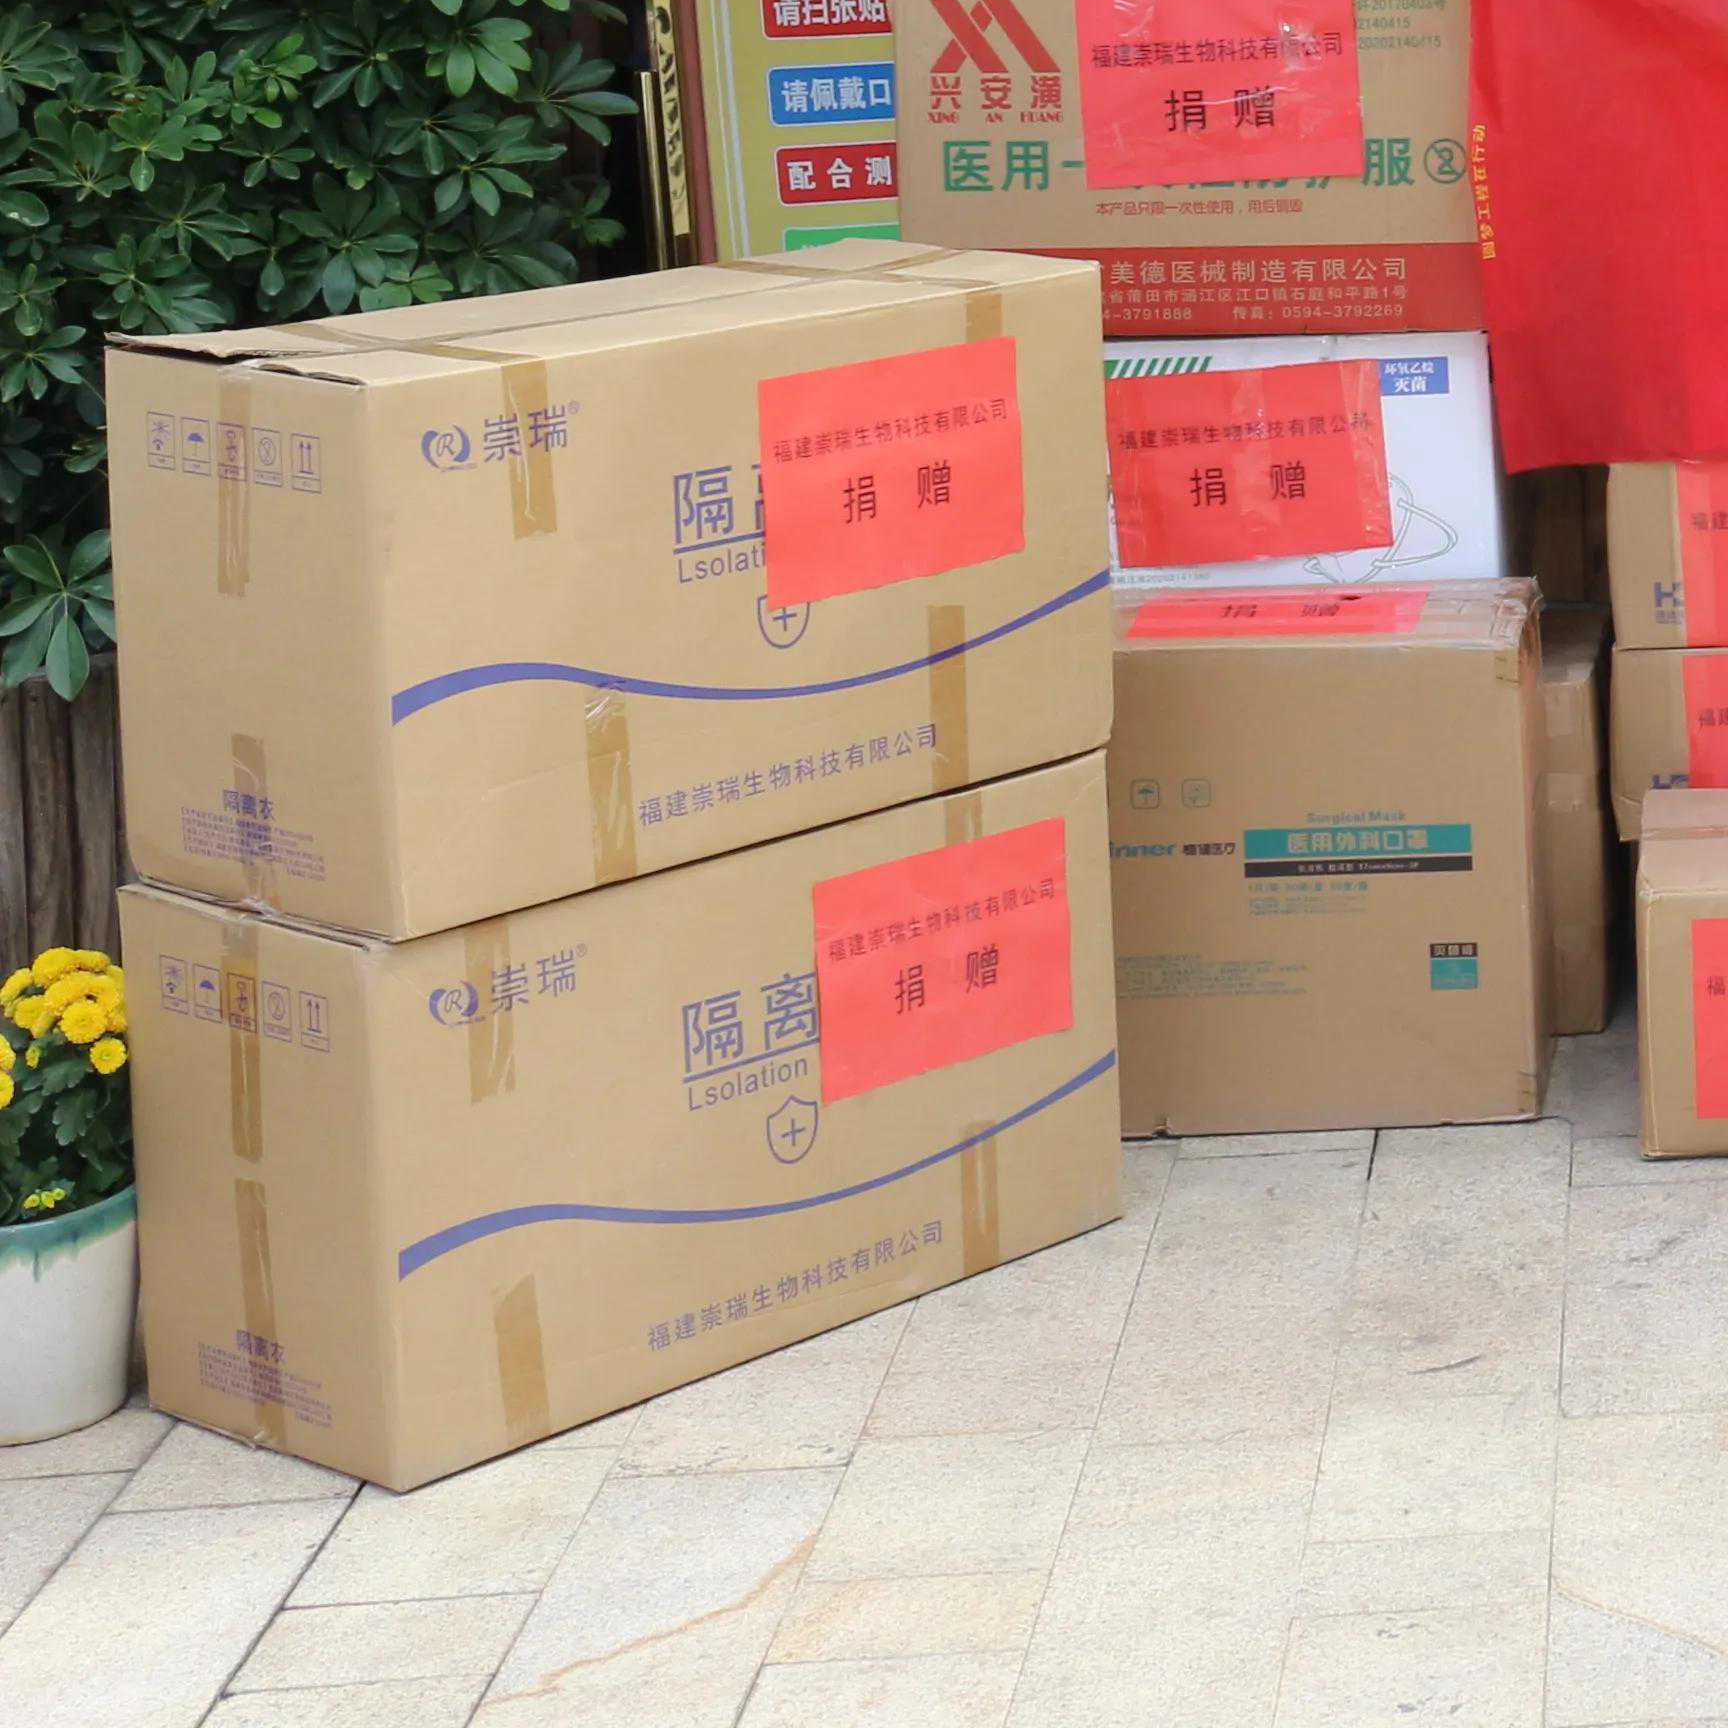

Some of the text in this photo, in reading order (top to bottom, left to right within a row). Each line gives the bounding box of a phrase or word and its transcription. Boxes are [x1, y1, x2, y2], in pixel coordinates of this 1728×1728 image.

[782, 76, 891, 115] 请佩戴口
[1166, 84, 1276, 134] 捐赠
[787, 155, 893, 191] 配合测
[1099, 257, 1407, 284] 美德医械制造有限公司
[1102, 284, 1408, 305] 省莆田市涵江区江口镇石庭和平路1号
[483, 402, 569, 462] 崇瑞
[773, 397, 1008, 464] 福建崇瑞生物科技有限公司
[842, 460, 952, 525] 捐赠
[1189, 461, 1306, 509] 捐赠
[640, 723, 938, 828] 福建崇瑞生物科技有限公司
[829, 876, 1057, 963] 福建崇瑞生物科技有限公司
[491, 948, 578, 1015] 崇瑞
[896, 943, 1001, 1016] 捐赠
[687, 1056, 809, 1112] Lsolation
[647, 1219, 944, 1352] 福建崇瑞生物科技有限公司
